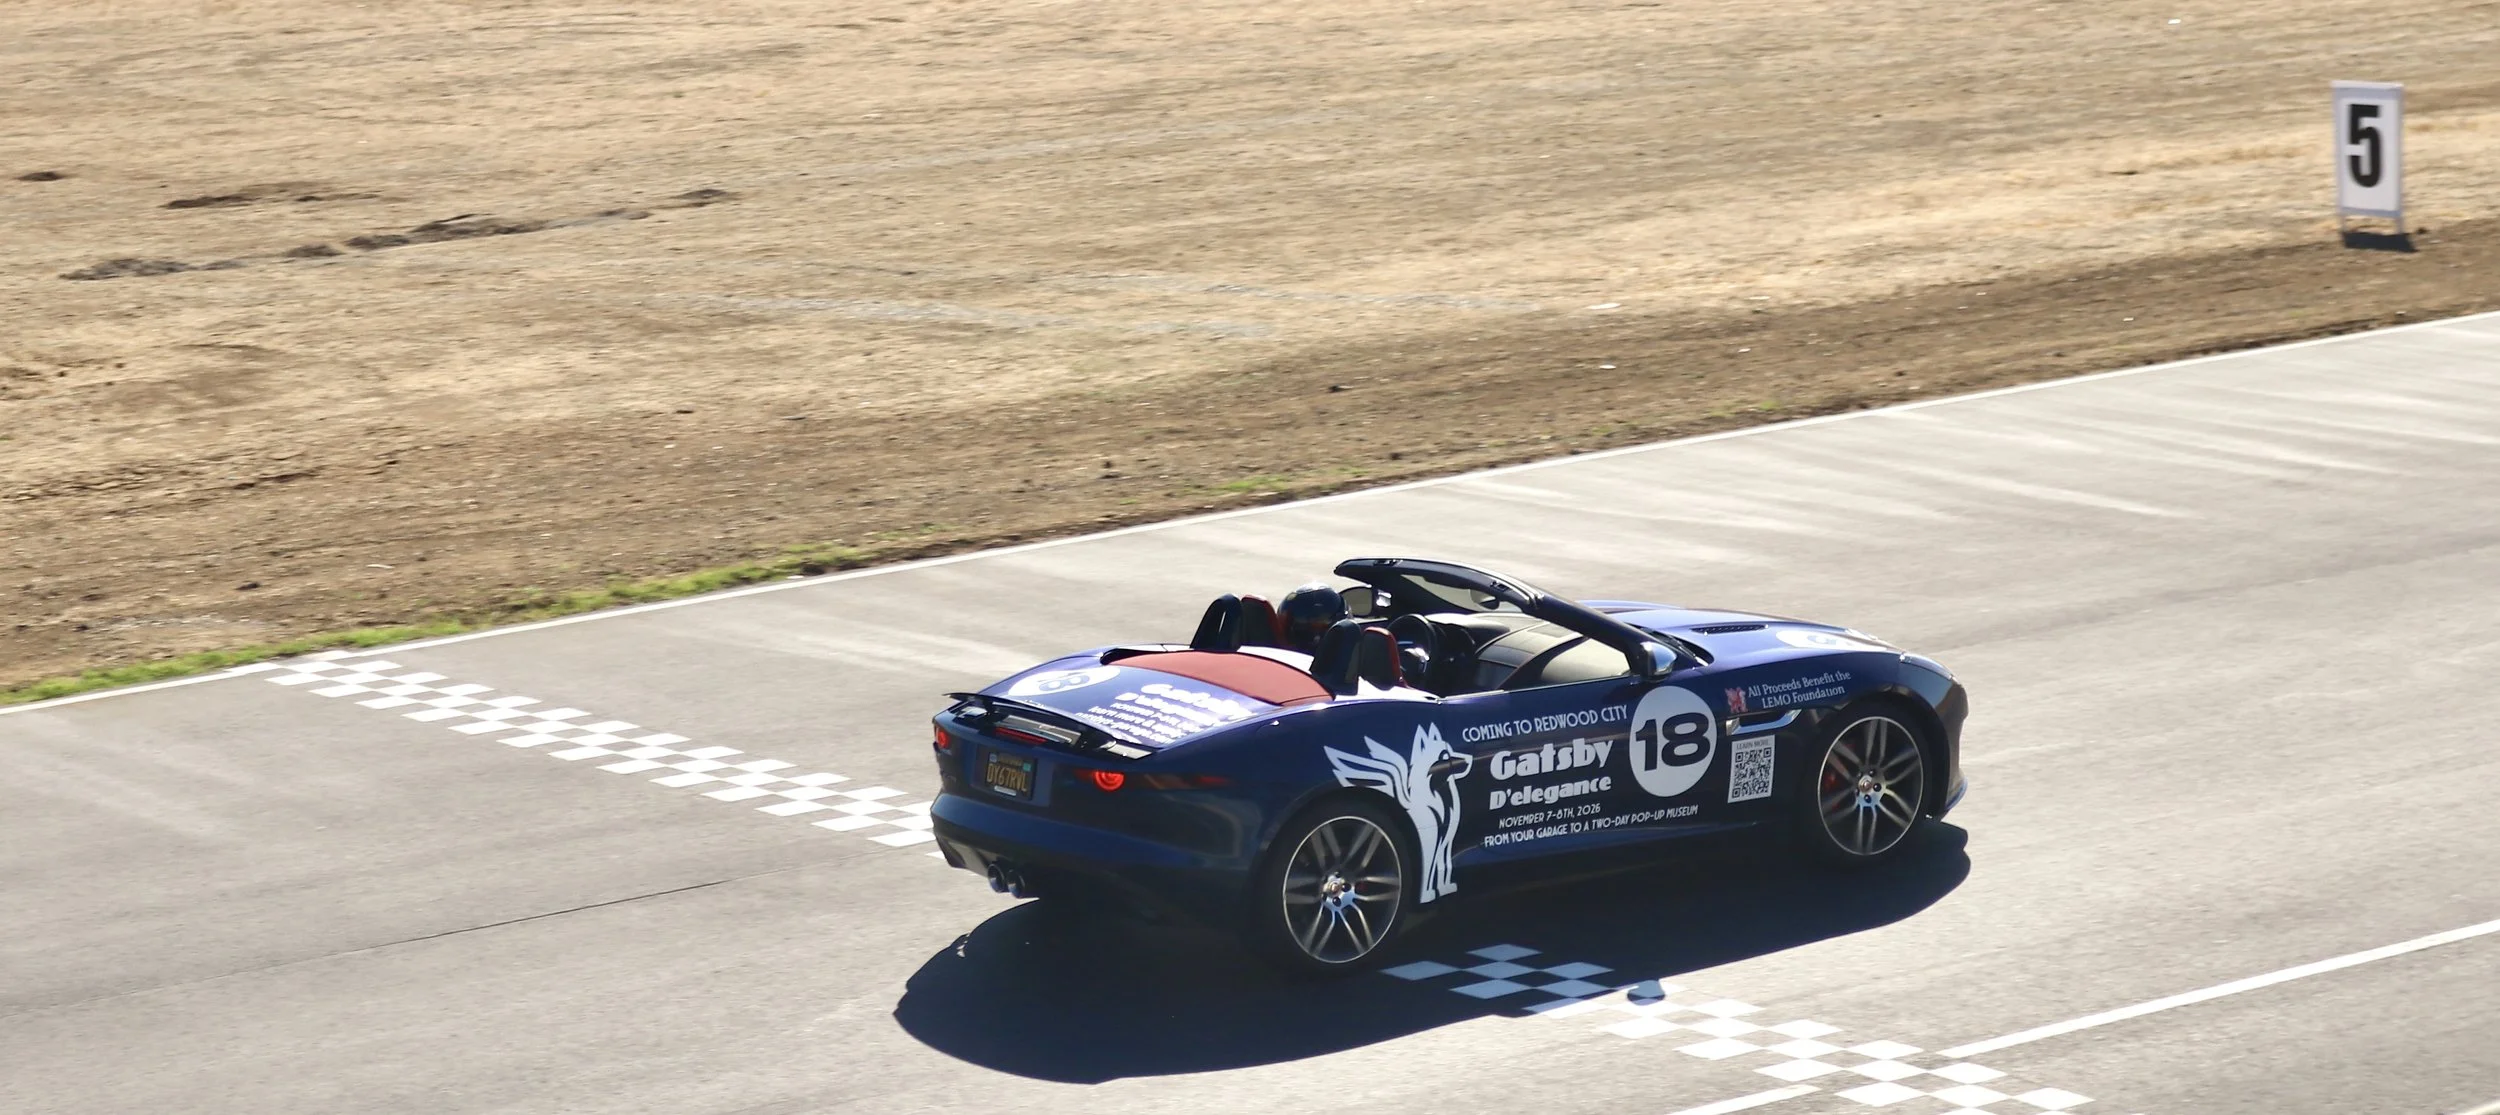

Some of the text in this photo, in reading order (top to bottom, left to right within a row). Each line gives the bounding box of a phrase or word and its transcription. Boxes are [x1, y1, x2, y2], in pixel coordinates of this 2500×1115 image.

[2348, 104, 2381, 187] 5
[1748, 670, 1851, 698] All Proceeds Benefit the
[1762, 685, 1845, 709] LEMO Foundation
[1462, 704, 1627, 742] COMING TO REDWOOD CITY
[1490, 738, 1614, 780] Gatsby
[1635, 712, 1711, 772] 18
[987, 763, 1027, 792] DY67RVL
[1489, 776, 1612, 810] D'elegance
[1484, 804, 1699, 848] FROM YOUR GARAGE TO A TWO-DAY POP-UP MUSEUM
[1499, 803, 1601, 829] NOVEMBER 7-8TH, 2026
